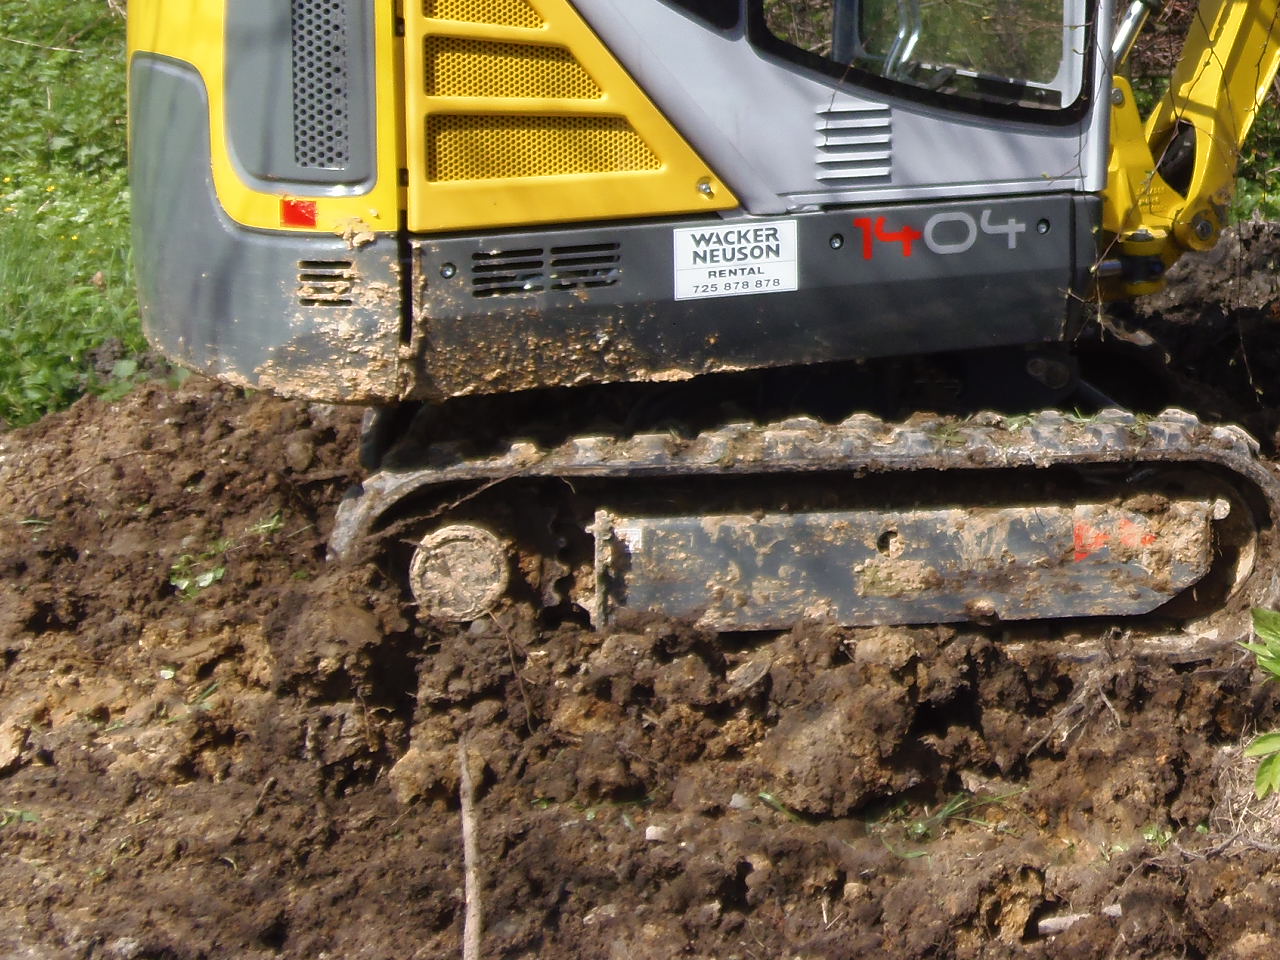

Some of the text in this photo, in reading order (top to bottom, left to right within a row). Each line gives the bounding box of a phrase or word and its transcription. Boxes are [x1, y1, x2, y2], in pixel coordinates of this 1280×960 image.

[690, 227, 780, 248] WACKER
[853, 209, 1026, 260] 1404
[692, 243, 780, 265] NEUSON
[708, 266, 765, 279] RENTAL
[693, 278, 780, 294] 725 878 878
